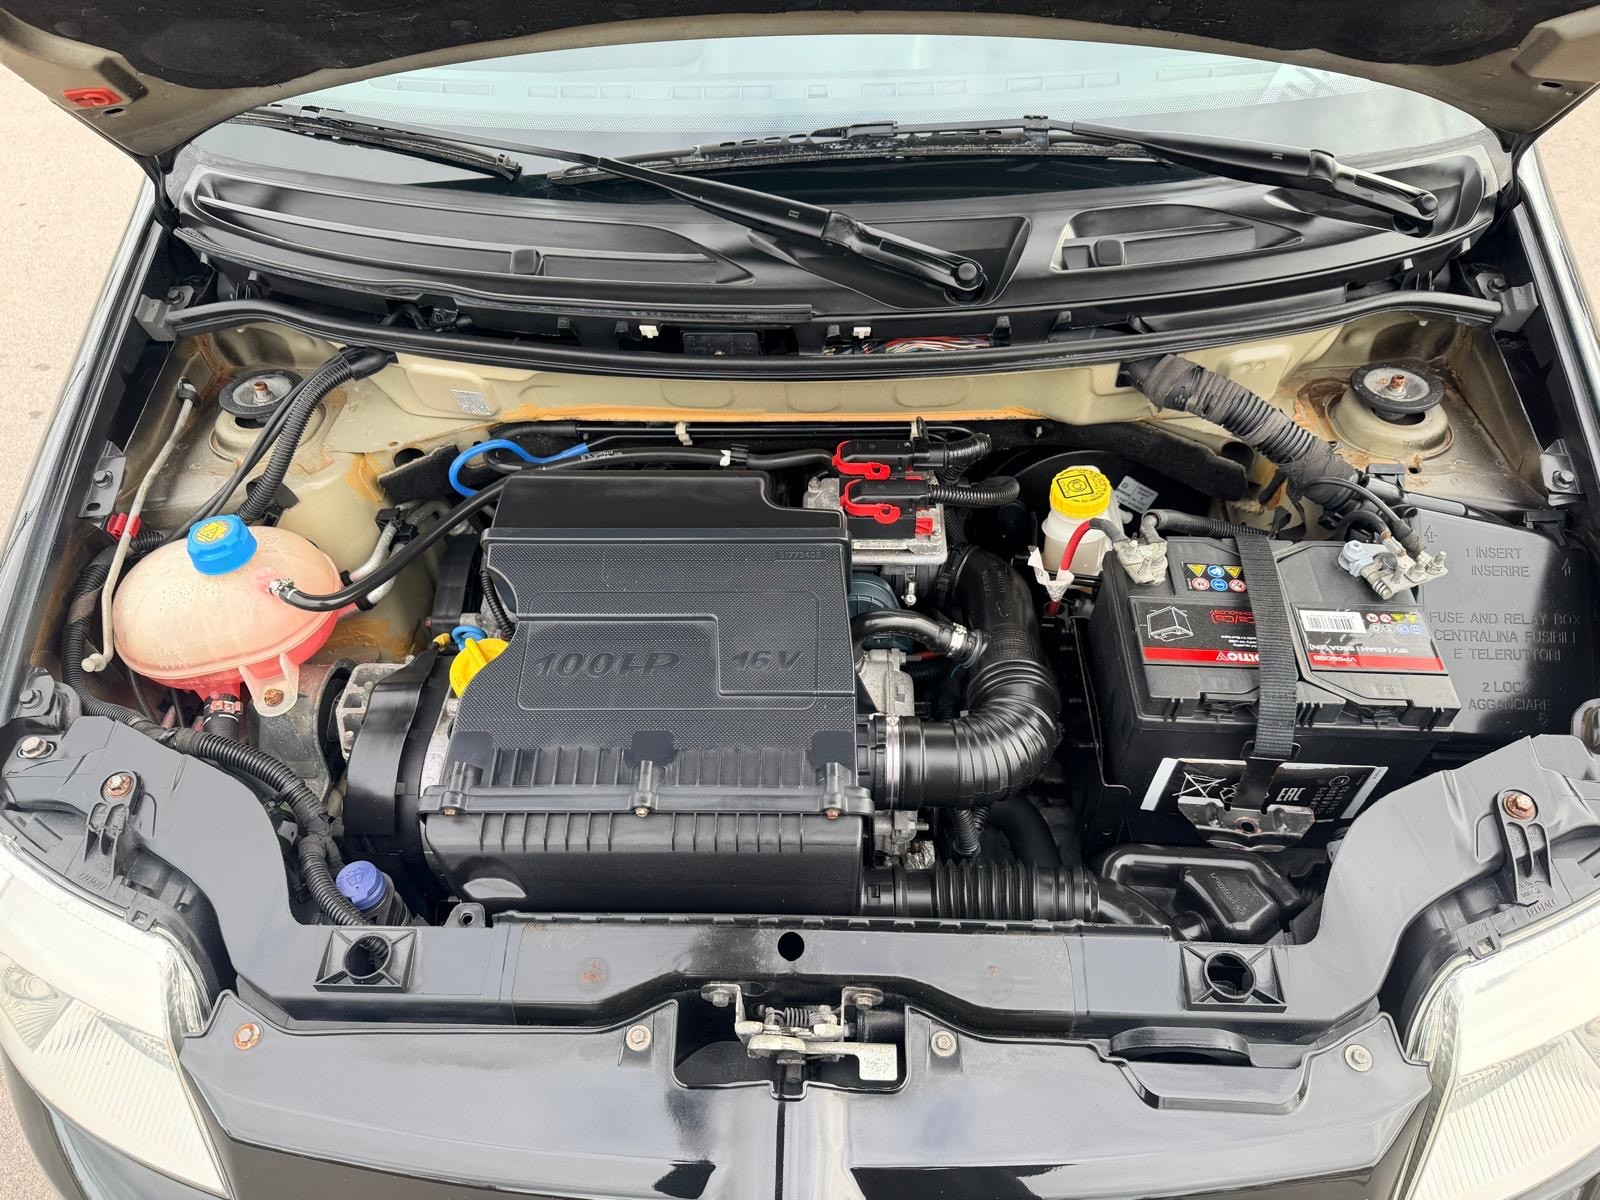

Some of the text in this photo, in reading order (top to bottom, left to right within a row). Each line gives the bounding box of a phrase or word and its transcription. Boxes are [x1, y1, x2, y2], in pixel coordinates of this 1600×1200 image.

[1476, 547, 1522, 559] INSERT
[1471, 565, 1530, 578] INSERIRE
[1429, 611, 1582, 626] FUSE AND RELAY BOX
[1433, 629, 1576, 644] CENTRALINA FUSIBILI
[1454, 649, 1562, 662] E TELERUTTORI
[535, 651, 683, 678] 100HP
[1482, 681, 1530, 693] 2 LOCK
[1275, 787, 1306, 802] EAC
